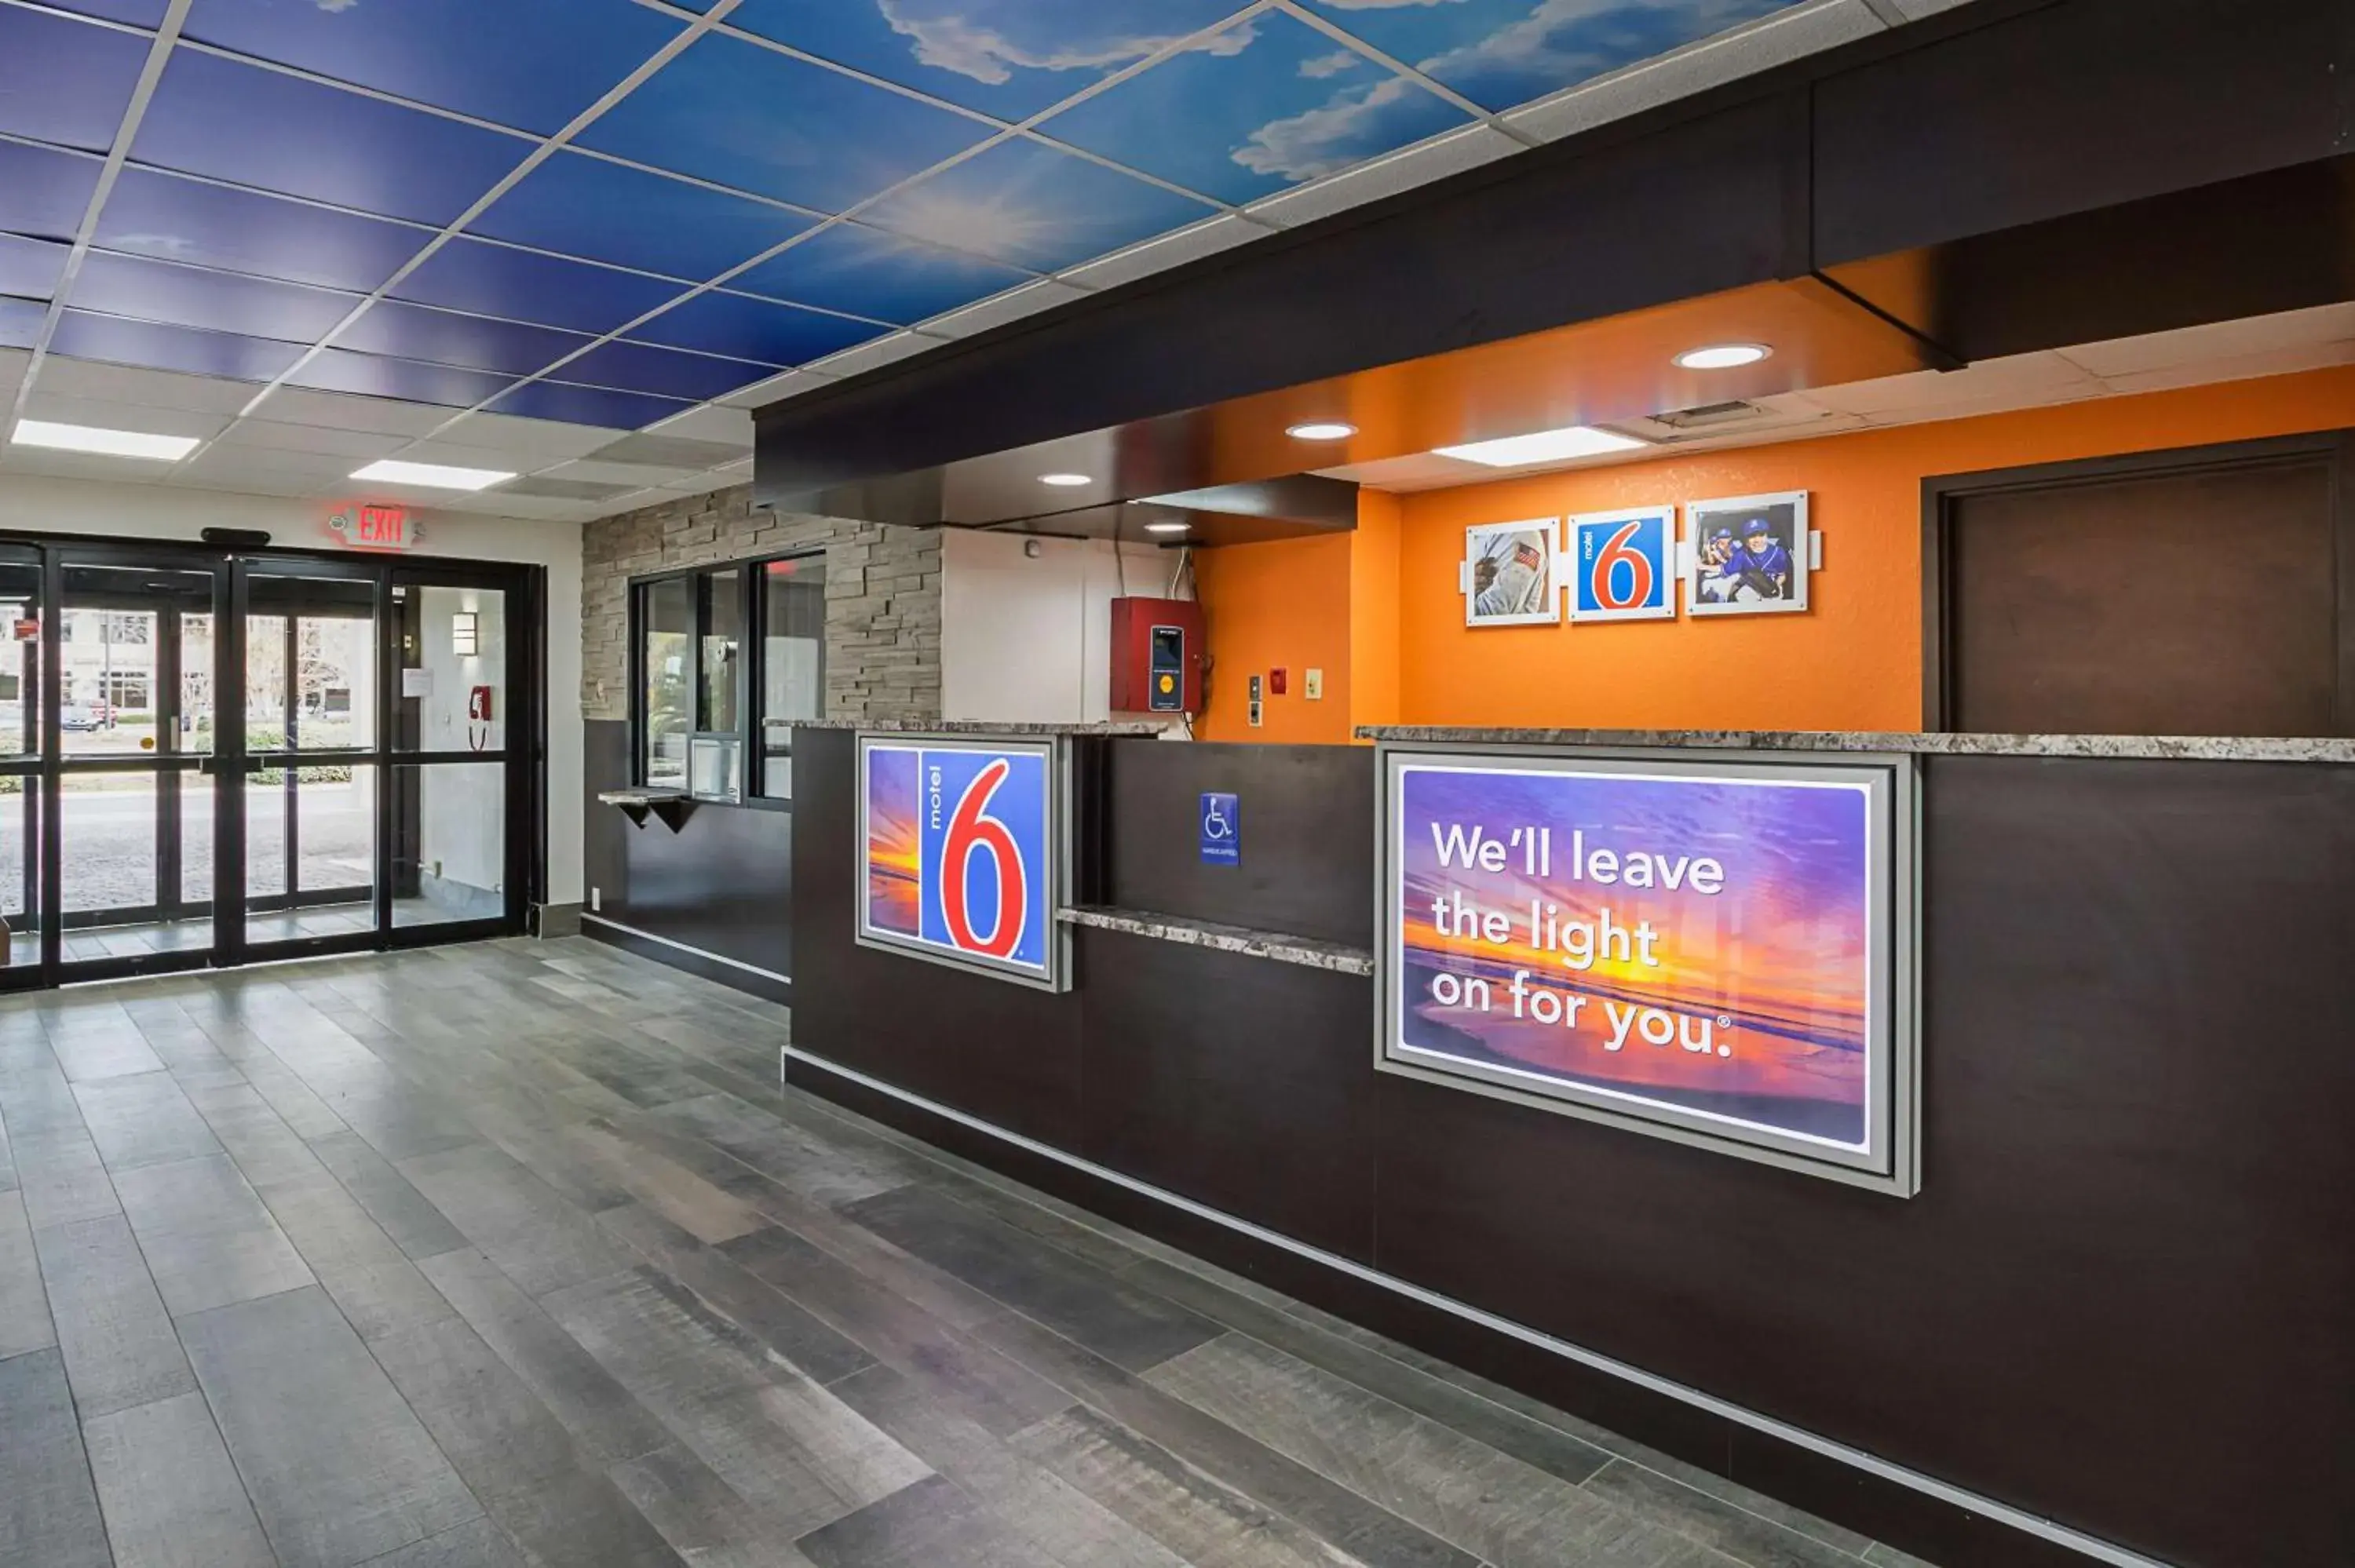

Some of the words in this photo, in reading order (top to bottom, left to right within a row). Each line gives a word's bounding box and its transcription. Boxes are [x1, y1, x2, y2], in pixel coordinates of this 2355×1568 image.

[360, 509, 402, 542] EXIT
[1583, 531, 1593, 559] motel
[1591, 520, 1653, 610] 6
[929, 766, 941, 830] motel
[940, 758, 1027, 960] 6
[1432, 822, 1550, 877] We’ll
[1572, 830, 1724, 894] leave
[1432, 891, 1510, 943] the
[1532, 901, 1659, 969] light
[1432, 972, 1489, 1012] on
[1510, 970, 1586, 1029] for
